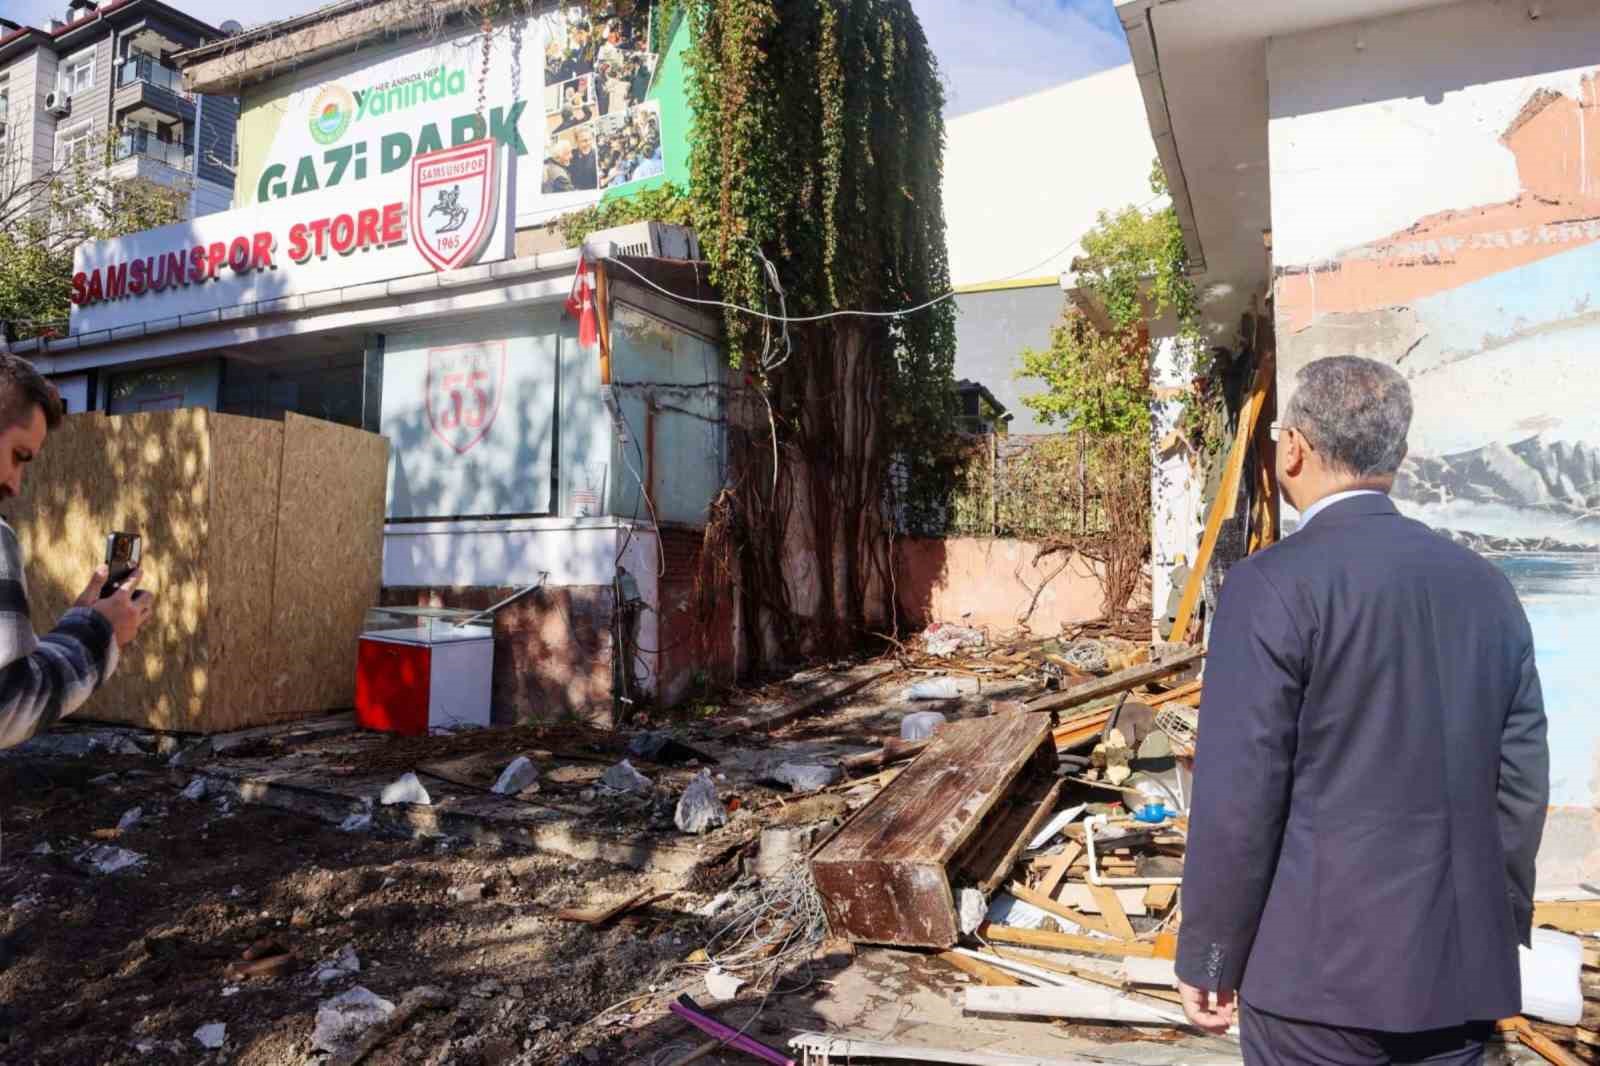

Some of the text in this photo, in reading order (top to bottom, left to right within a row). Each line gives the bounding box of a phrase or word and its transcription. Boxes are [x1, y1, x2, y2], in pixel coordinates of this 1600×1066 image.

[422, 158, 484, 180] SAMSUNSPOR
[71, 201, 404, 306] SAMSUNSPOR STORE
[437, 234, 460, 250] 1965
[441, 370, 489, 430] 55
